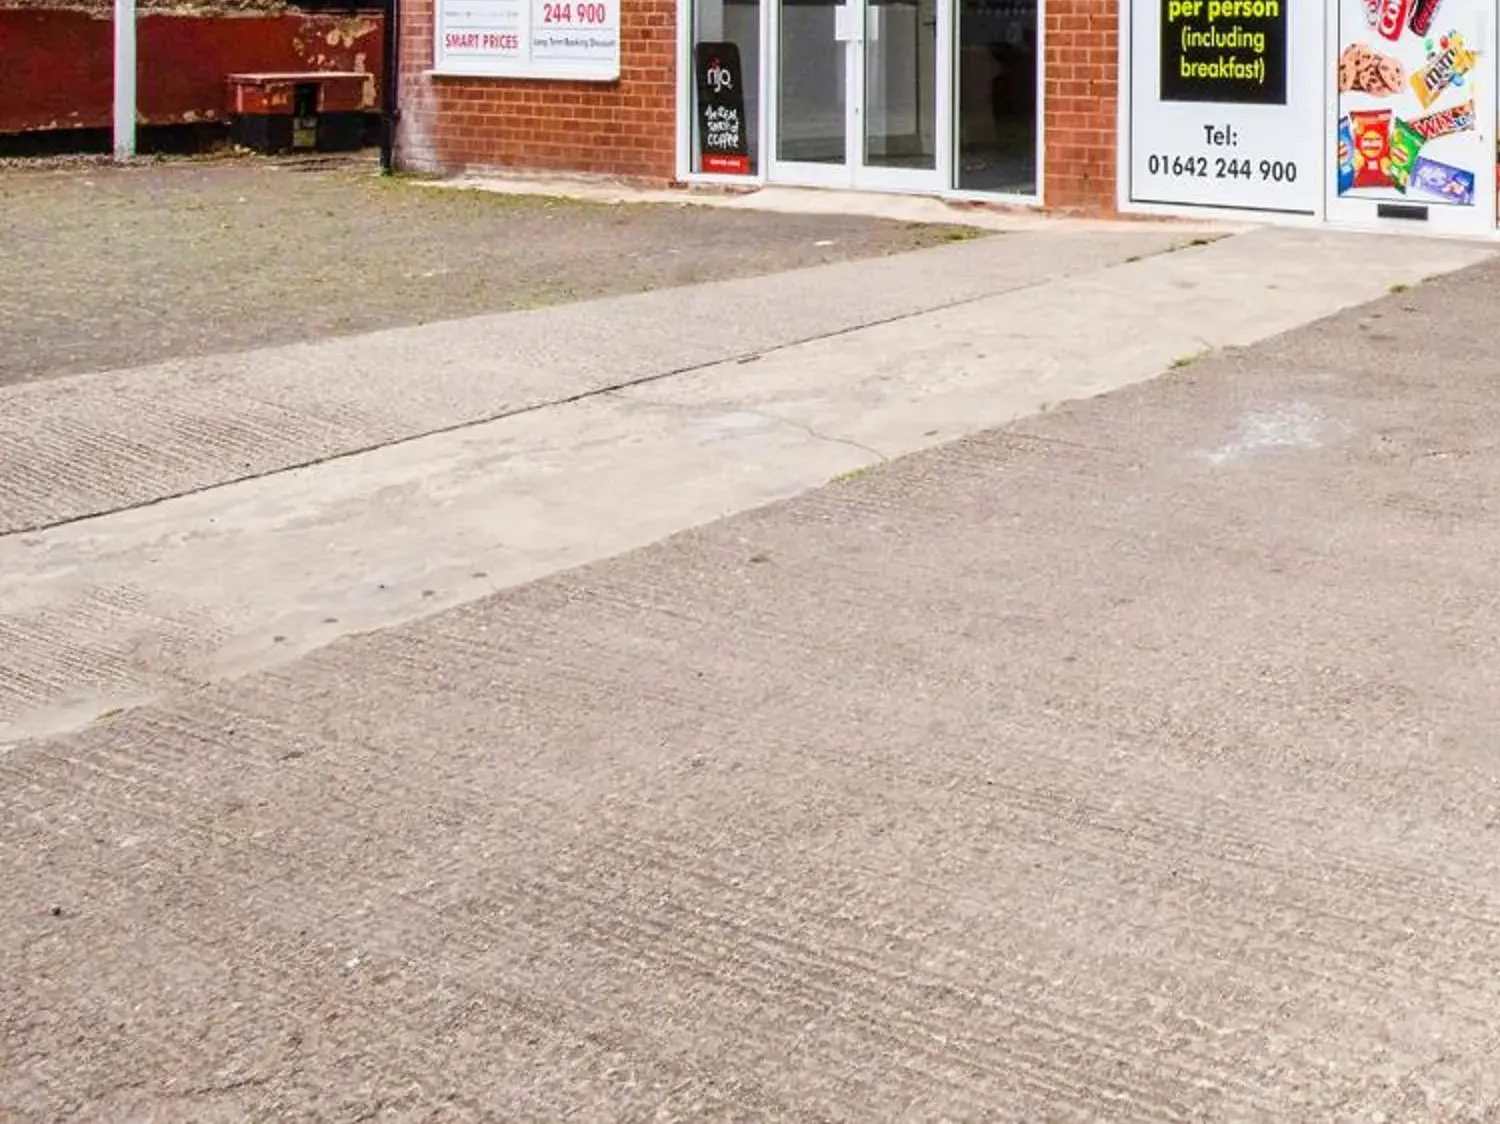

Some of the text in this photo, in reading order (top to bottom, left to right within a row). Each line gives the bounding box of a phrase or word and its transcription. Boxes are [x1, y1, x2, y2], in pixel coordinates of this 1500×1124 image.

[543, 3, 606, 23] 244 900
[1168, 0, 1279, 22] per person
[445, 34, 518, 49] SMART PRICES
[1181, 26, 1265, 53] (including
[1180, 56, 1265, 84] breakfast)
[1203, 124, 1238, 146] Tel:
[1148, 154, 1297, 182] 01642 244 900
